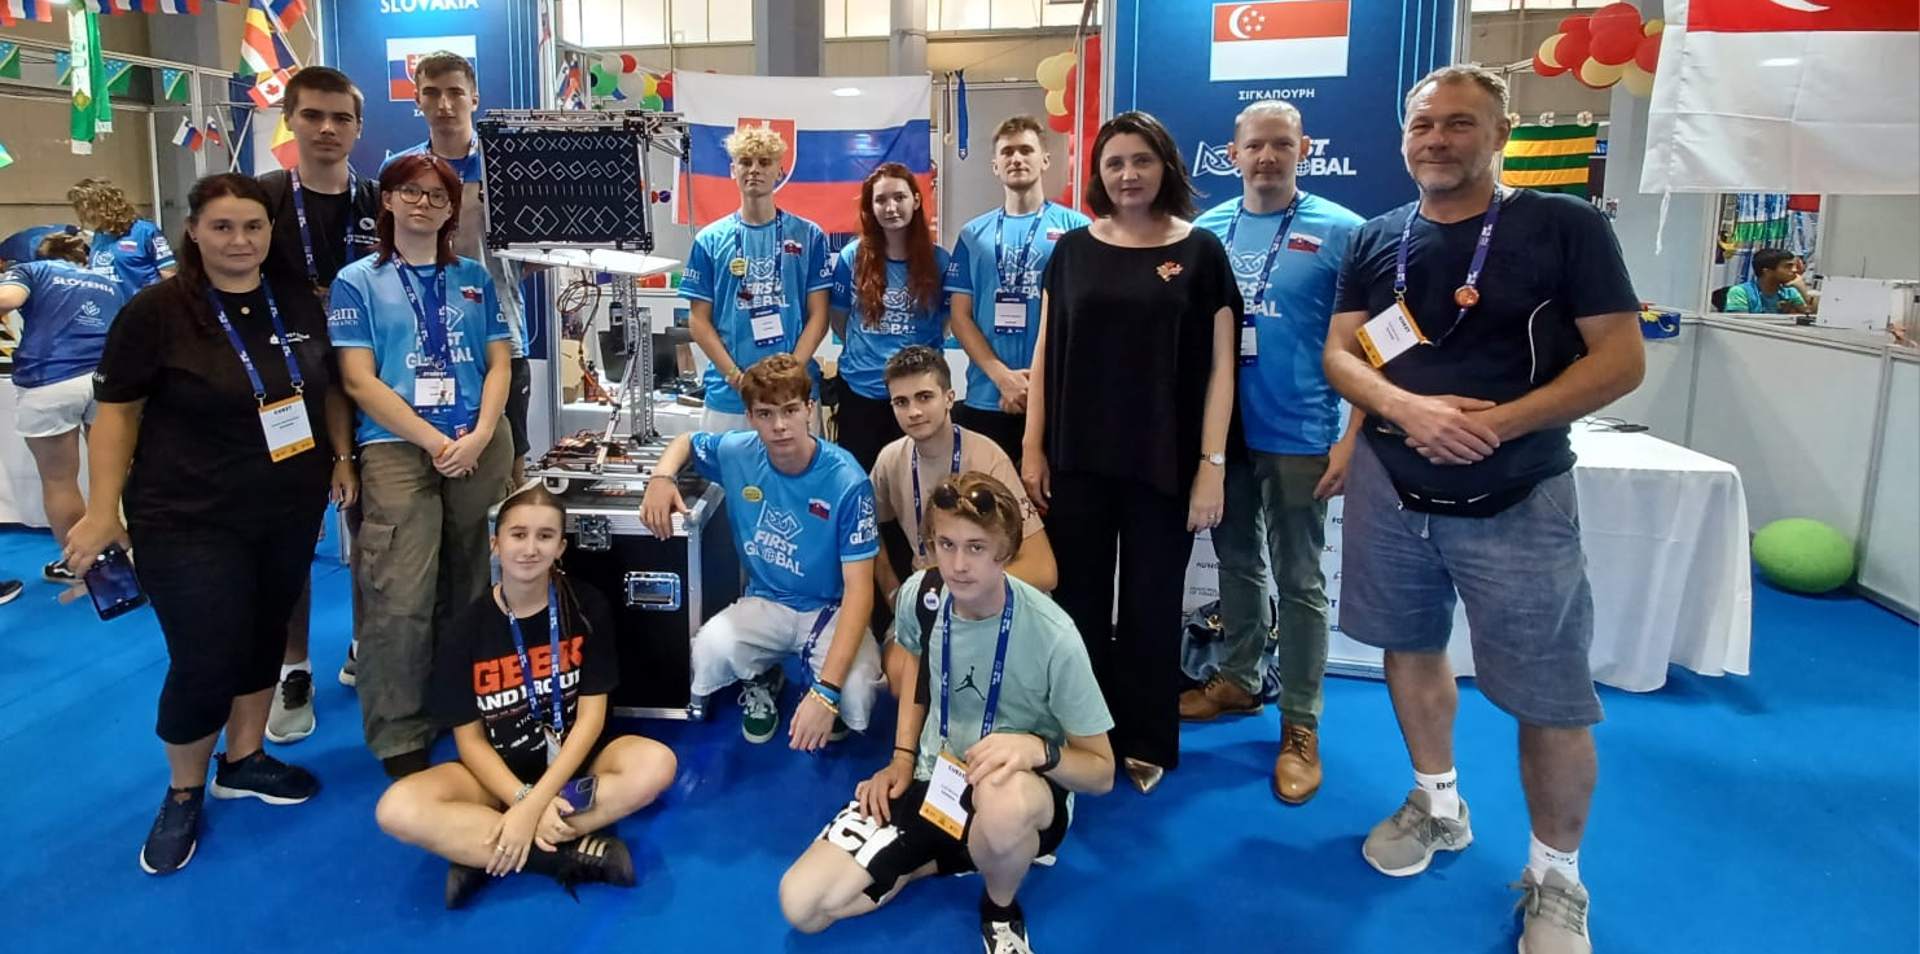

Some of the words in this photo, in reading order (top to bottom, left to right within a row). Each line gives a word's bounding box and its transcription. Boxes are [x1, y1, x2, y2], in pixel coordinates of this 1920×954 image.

[1238, 88, 1316, 101] ΣΙΓΚΑΠΟΥΡΗ
[52, 276, 116, 296] SLOVENIA
[754, 530, 799, 556] FIRST
[743, 540, 806, 578] GLOBAL
[473, 635, 585, 695] GEEK
